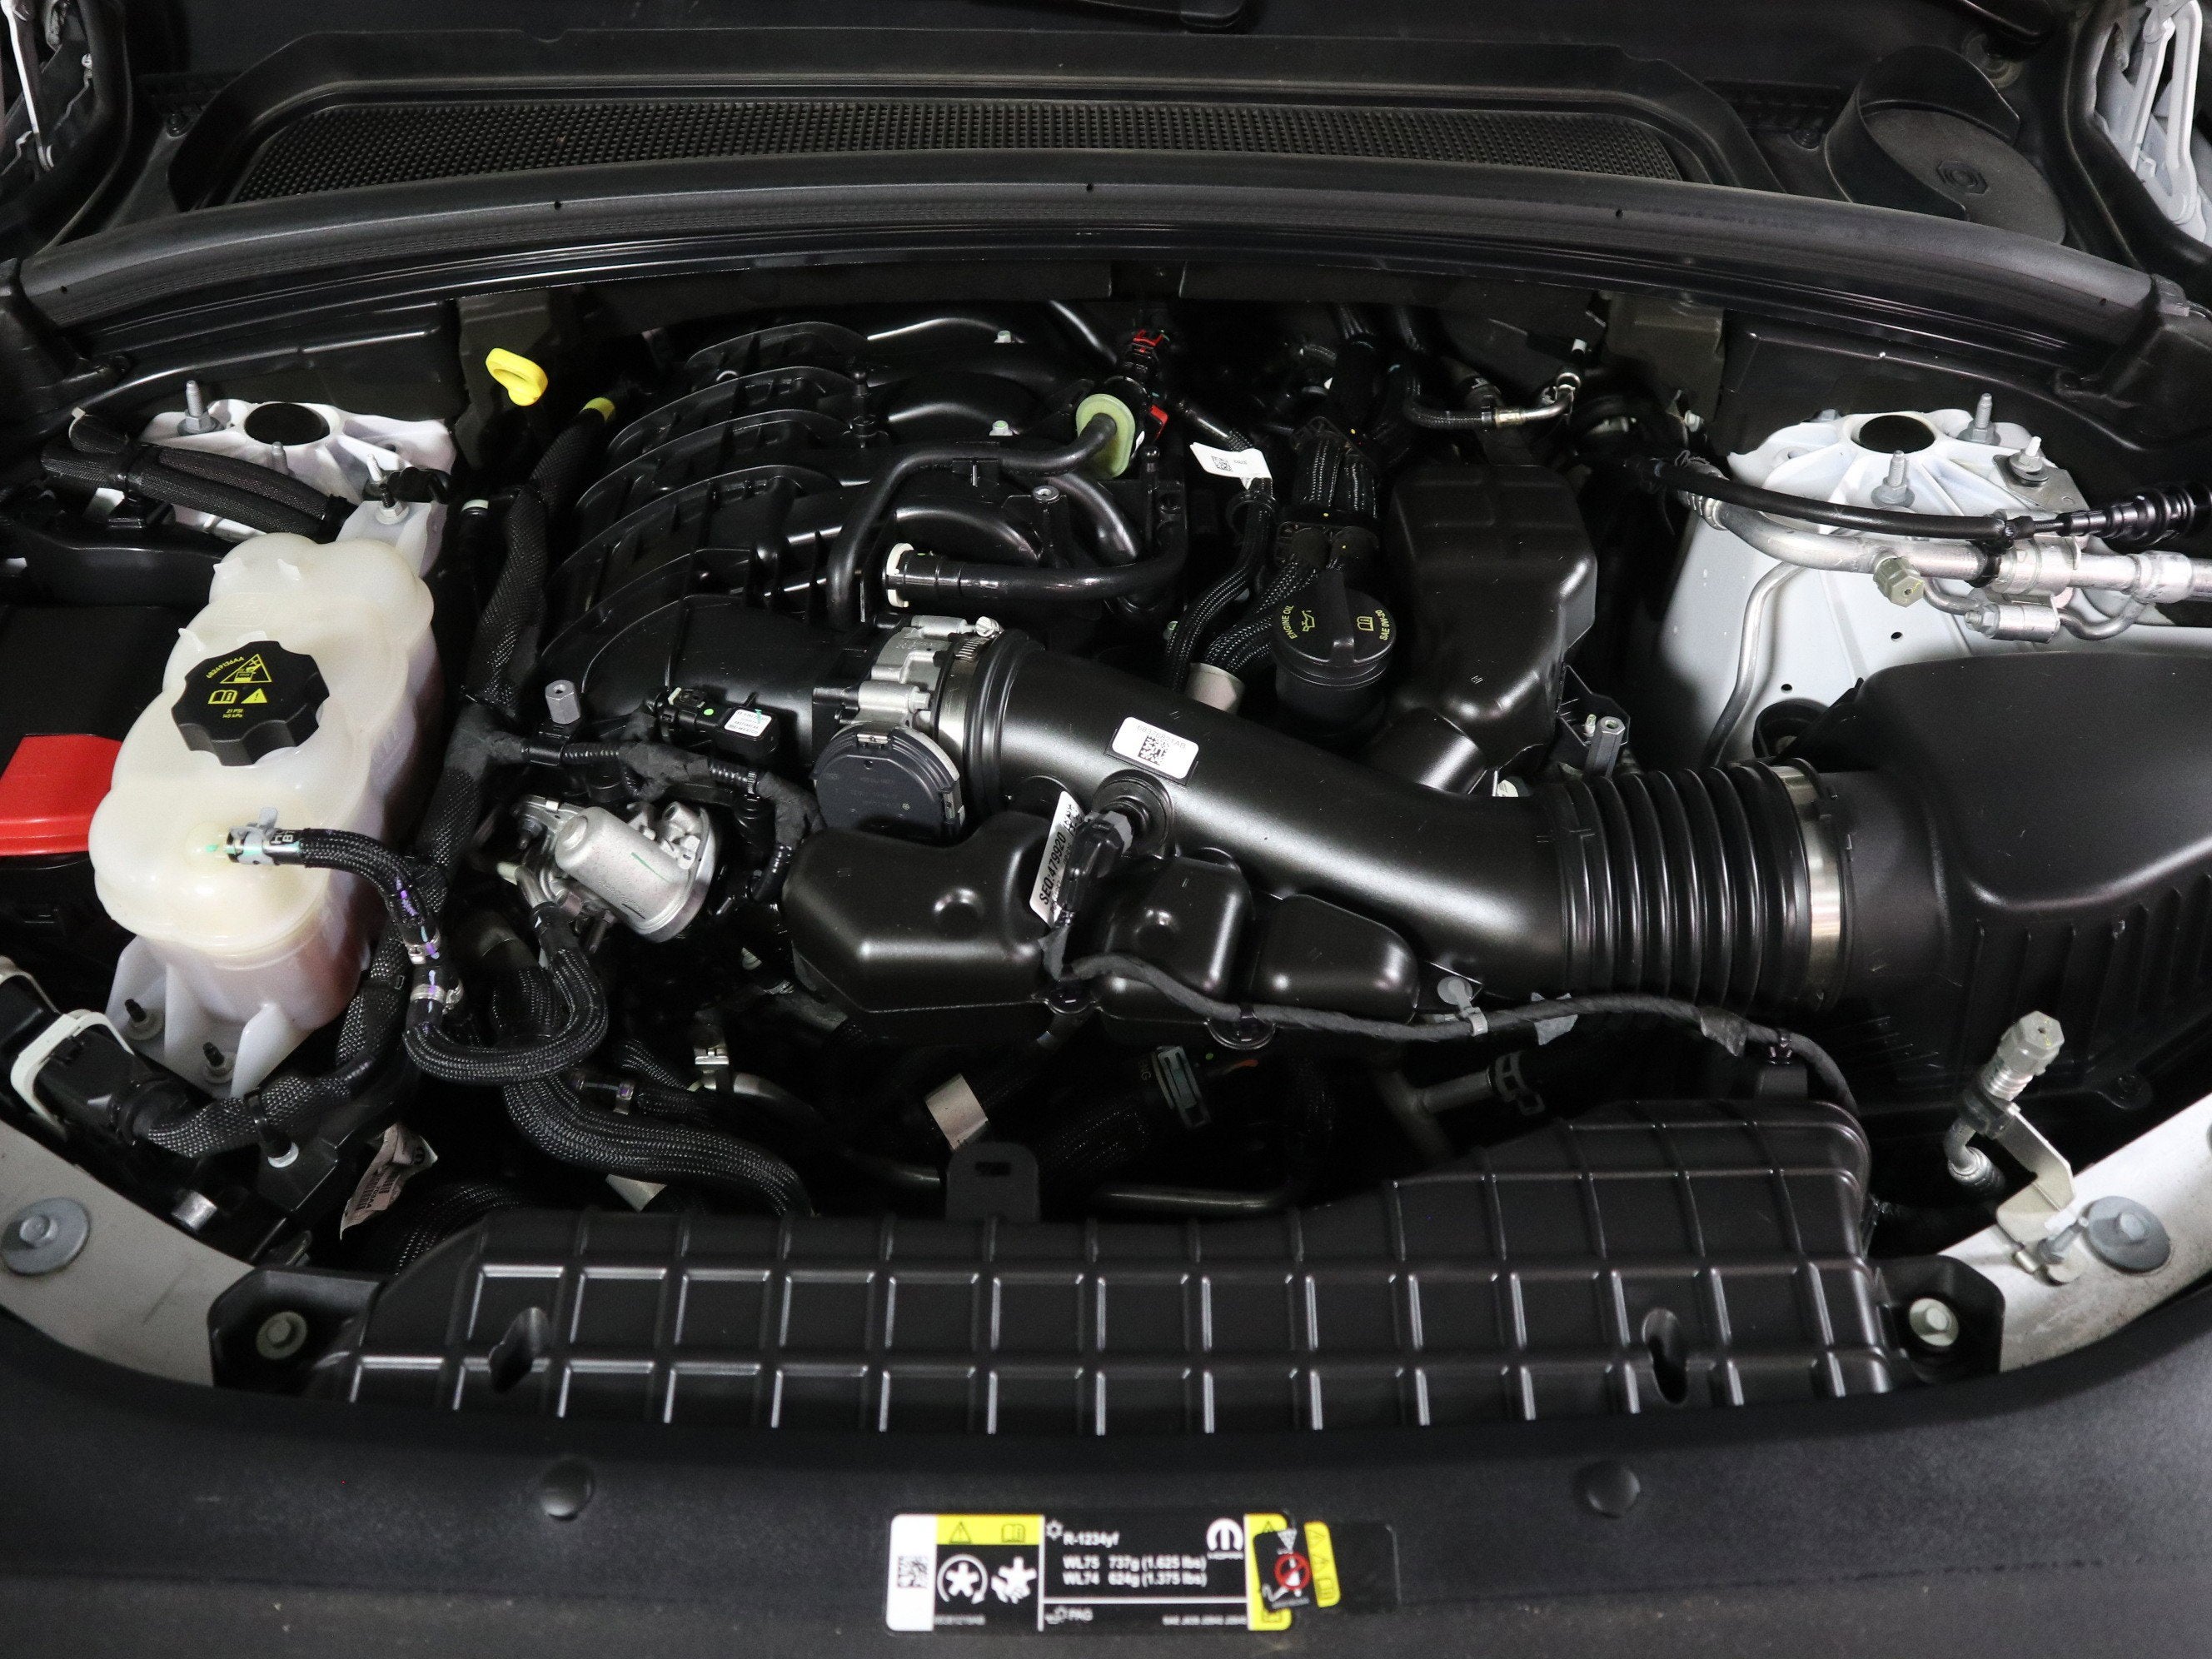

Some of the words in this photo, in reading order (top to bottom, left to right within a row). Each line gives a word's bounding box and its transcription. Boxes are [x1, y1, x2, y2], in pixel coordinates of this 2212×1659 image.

[1283, 605, 1294, 615] OIL
[1281, 615, 1298, 640] ENGINE
[1375, 610, 1389, 628] 0W-20
[1378, 627, 1391, 641] SAE
[1039, 831, 1067, 905] SEQ:479920
[1063, 1531, 1120, 1548] R-1234yf
[1063, 1555, 1101, 1569] WL75
[1108, 1555, 1140, 1572] 737g
[1181, 1555, 1207, 1572] lbs)
[1063, 1571, 1101, 1586] WL74
[1108, 1571, 1140, 1588] 624g
[1181, 1571, 1207, 1588] lbs)
